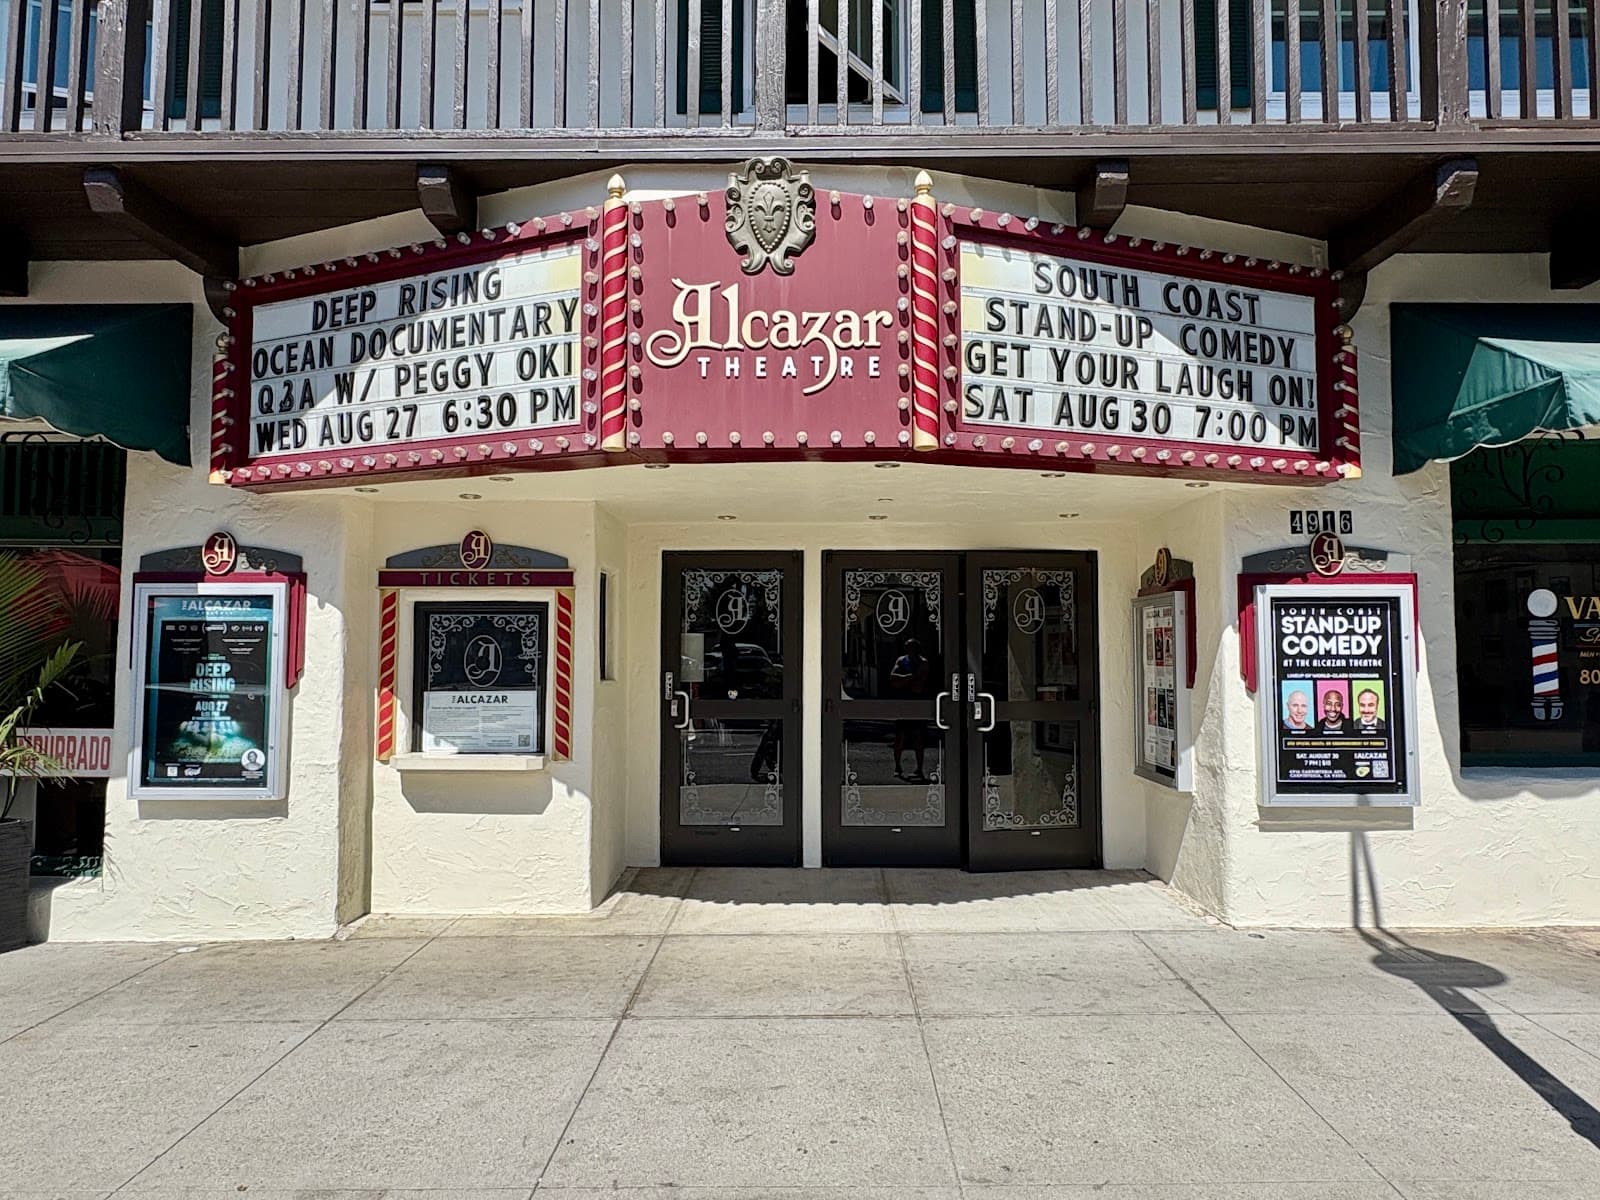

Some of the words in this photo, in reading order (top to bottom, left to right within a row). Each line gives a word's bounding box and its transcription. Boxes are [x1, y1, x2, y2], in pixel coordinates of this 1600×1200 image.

[312, 290, 376, 331] DEEP
[399, 267, 502, 316] RISING
[1033, 262, 1140, 307] SOUTH
[1163, 282, 1260, 325] COAST
[253, 336, 334, 379] OCEAN
[350, 297, 579, 364] DOCUMENTARY
[645, 278, 893, 395] Alcazar
[986, 297, 1153, 349] STAND-UP
[1180, 323, 1295, 369] COMEDY
[334, 368, 377, 405] W/
[395, 352, 495, 397] PEGGY
[515, 342, 573, 381] OKI
[697, 356, 881, 377] THEATRE
[965, 339, 1031, 378] GET
[1049, 347, 1139, 391] YOUR
[1156, 359, 1253, 402] LAUGH
[1269, 375, 1316, 408] ON!
[256, 417, 307, 453] WED
[319, 409, 373, 446] AUG
[386, 404, 419, 440] 27
[442, 392, 517, 433] 6:30
[530, 385, 577, 423] PM
[964, 383, 1033, 422] SAT
[1054, 391, 1119, 431] AUG
[1131, 399, 1171, 434] 30
[1195, 405, 1267, 443] 7:00
[1279, 413, 1317, 448] PM
[1292, 513, 1351, 532] 4916
[420, 572, 531, 585] TICKETS
[188, 600, 251, 611] ALCAZAR
[1281, 616, 1381, 634] STAND-UP
[1282, 635, 1382, 655] COMEDY
[196, 663, 231, 677] DEEP
[1283, 659, 1292, 667] AT
[1296, 659, 1310, 667] THE
[1312, 659, 1346, 667] ALCAZAR
[1349, 659, 1382, 667] THEATRE
[190, 678, 235, 692] RISING
[195, 701, 214, 711] AUG
[457, 695, 509, 704] ALCAZAR
